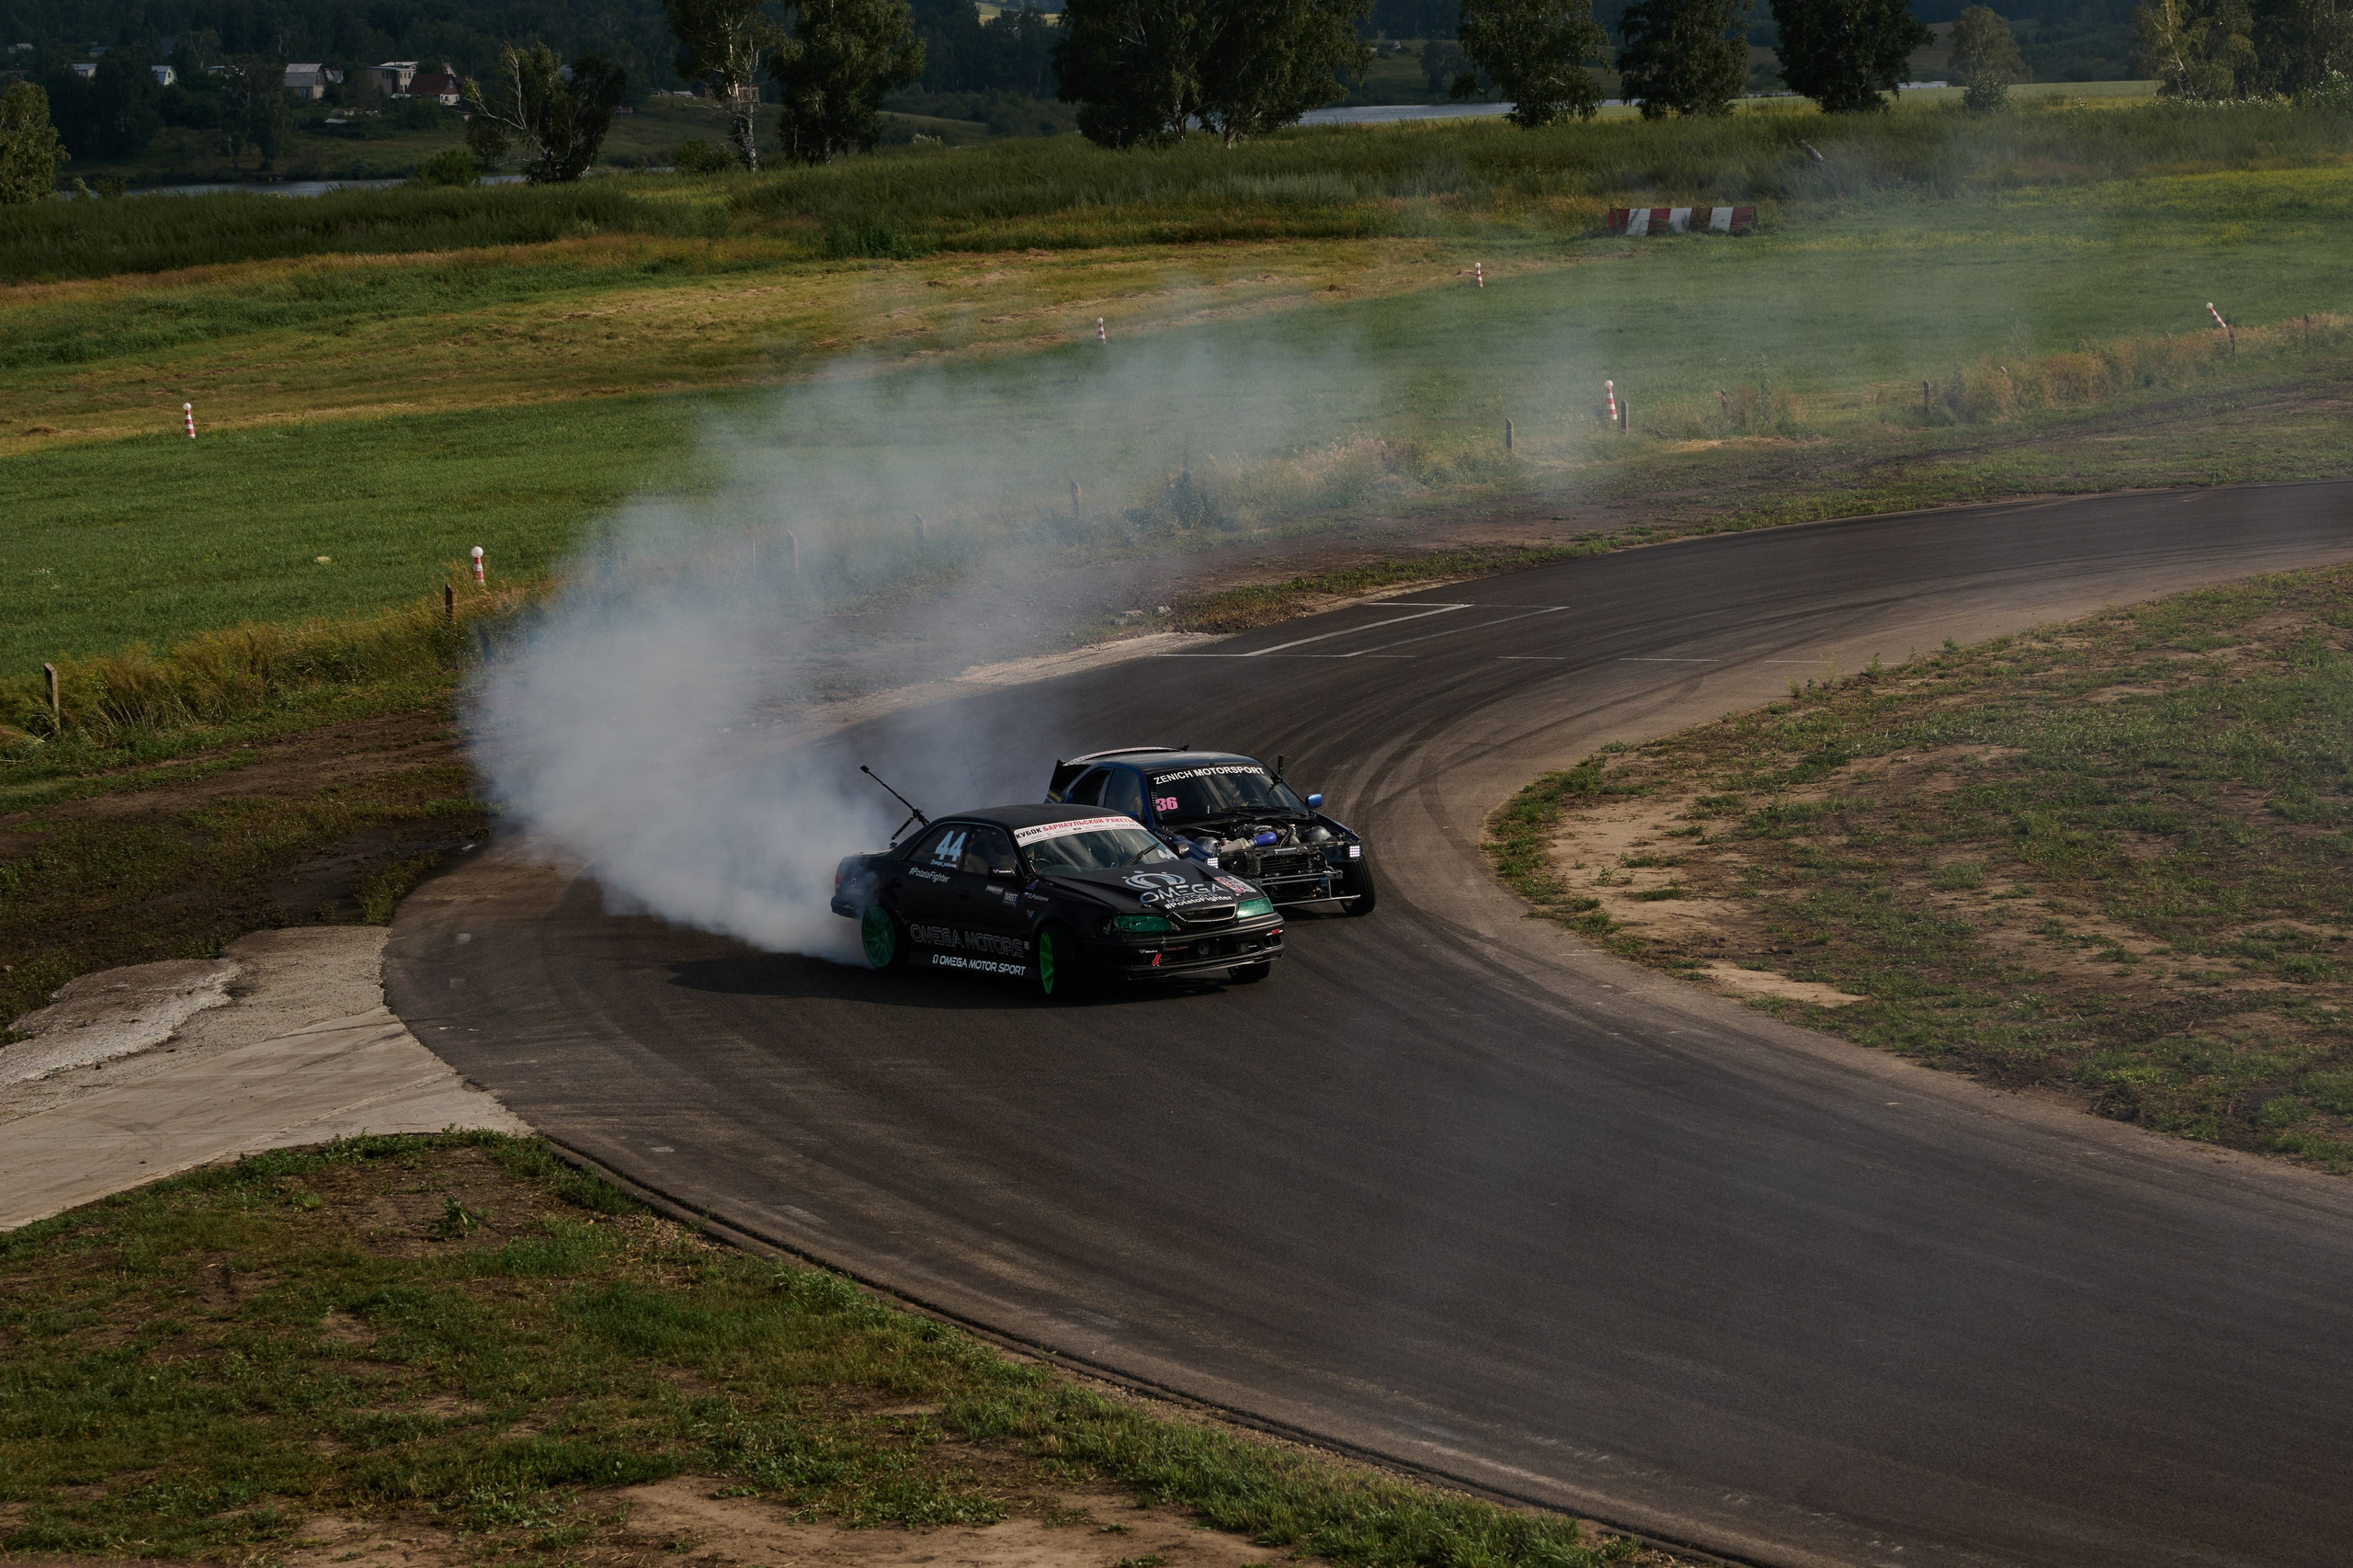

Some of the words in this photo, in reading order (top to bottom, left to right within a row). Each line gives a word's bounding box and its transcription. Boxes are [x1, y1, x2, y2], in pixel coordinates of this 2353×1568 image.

[1153, 770, 1193, 785] ZENICH
[1193, 767, 1265, 777] MOTORSPORT
[1154, 796, 1178, 812] 36
[1015, 827, 1041, 839] КУБОК
[1042, 818, 1104, 832] БАРНАУЛЬСКОЙ
[934, 830, 967, 862] 44
[909, 867, 949, 882] #PotatoFighter
[1139, 882, 1230, 903] OMEGA
[1164, 895, 1233, 910] #PotatoFighter
[910, 924, 964, 949] OMEGA
[964, 930, 1024, 958] MOTORS
[939, 955, 968, 968] OMEGA
[968, 959, 997, 971] MOTOR
[997, 963, 1026, 975] SPORT
